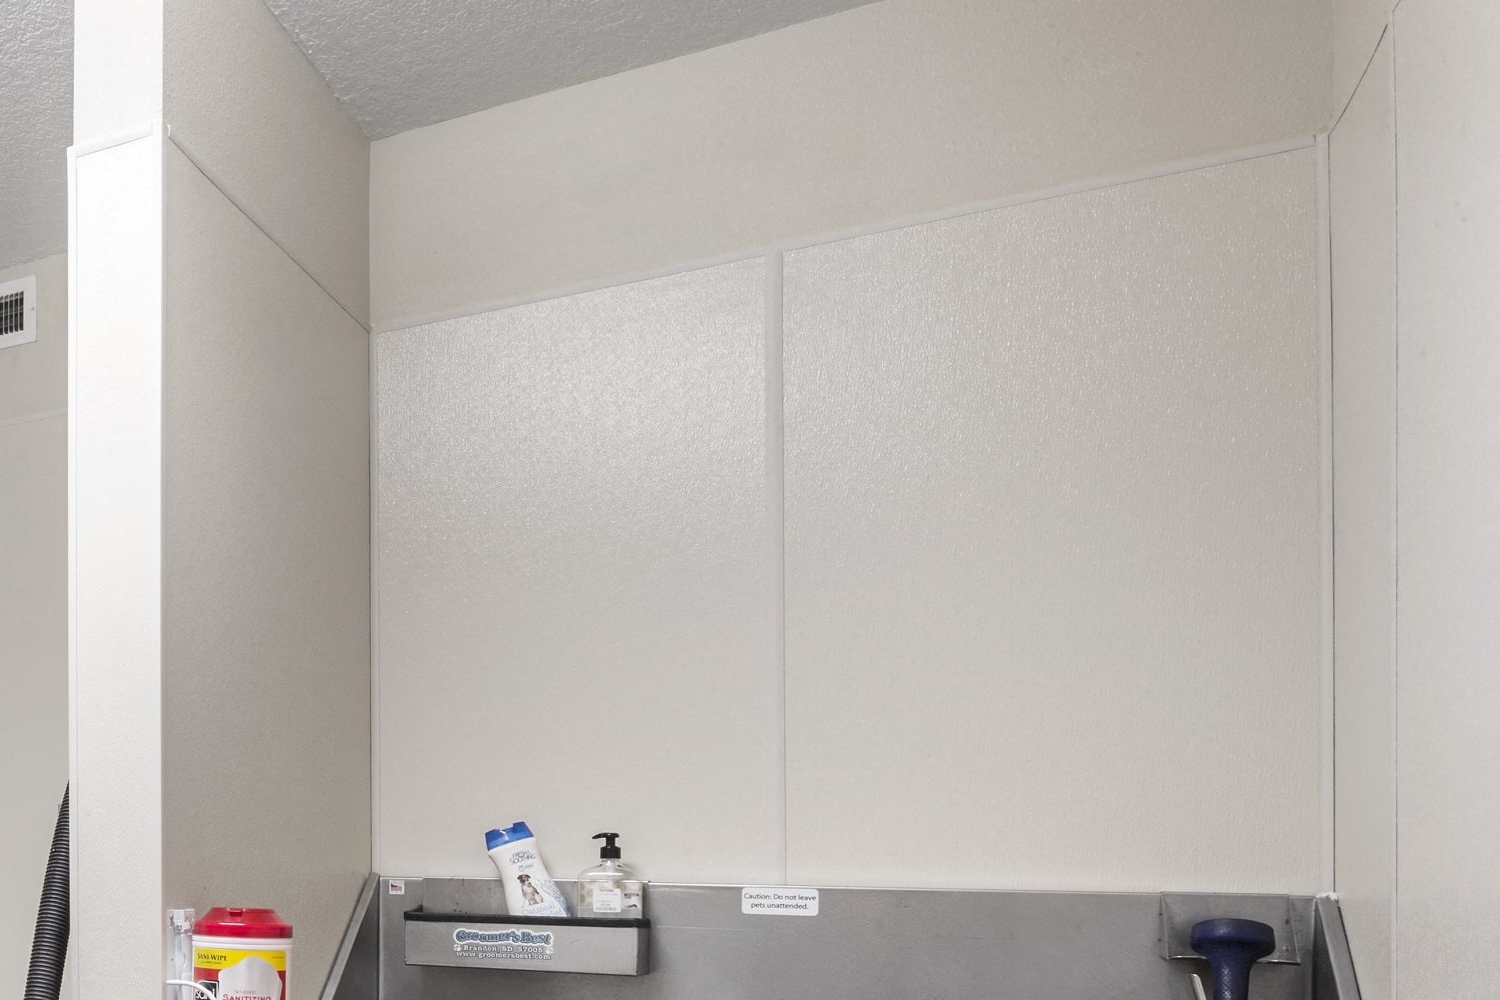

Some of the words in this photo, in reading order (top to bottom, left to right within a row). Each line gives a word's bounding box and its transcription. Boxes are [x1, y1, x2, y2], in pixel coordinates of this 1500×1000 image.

[455, 929, 519, 942] Groomer's
[520, 930, 552, 945] Best
[463, 944, 500, 952] Brandon,
[197, 953, 228, 961] SANI-WIPE
[456, 951, 552, 960] www.groomersbest.com
